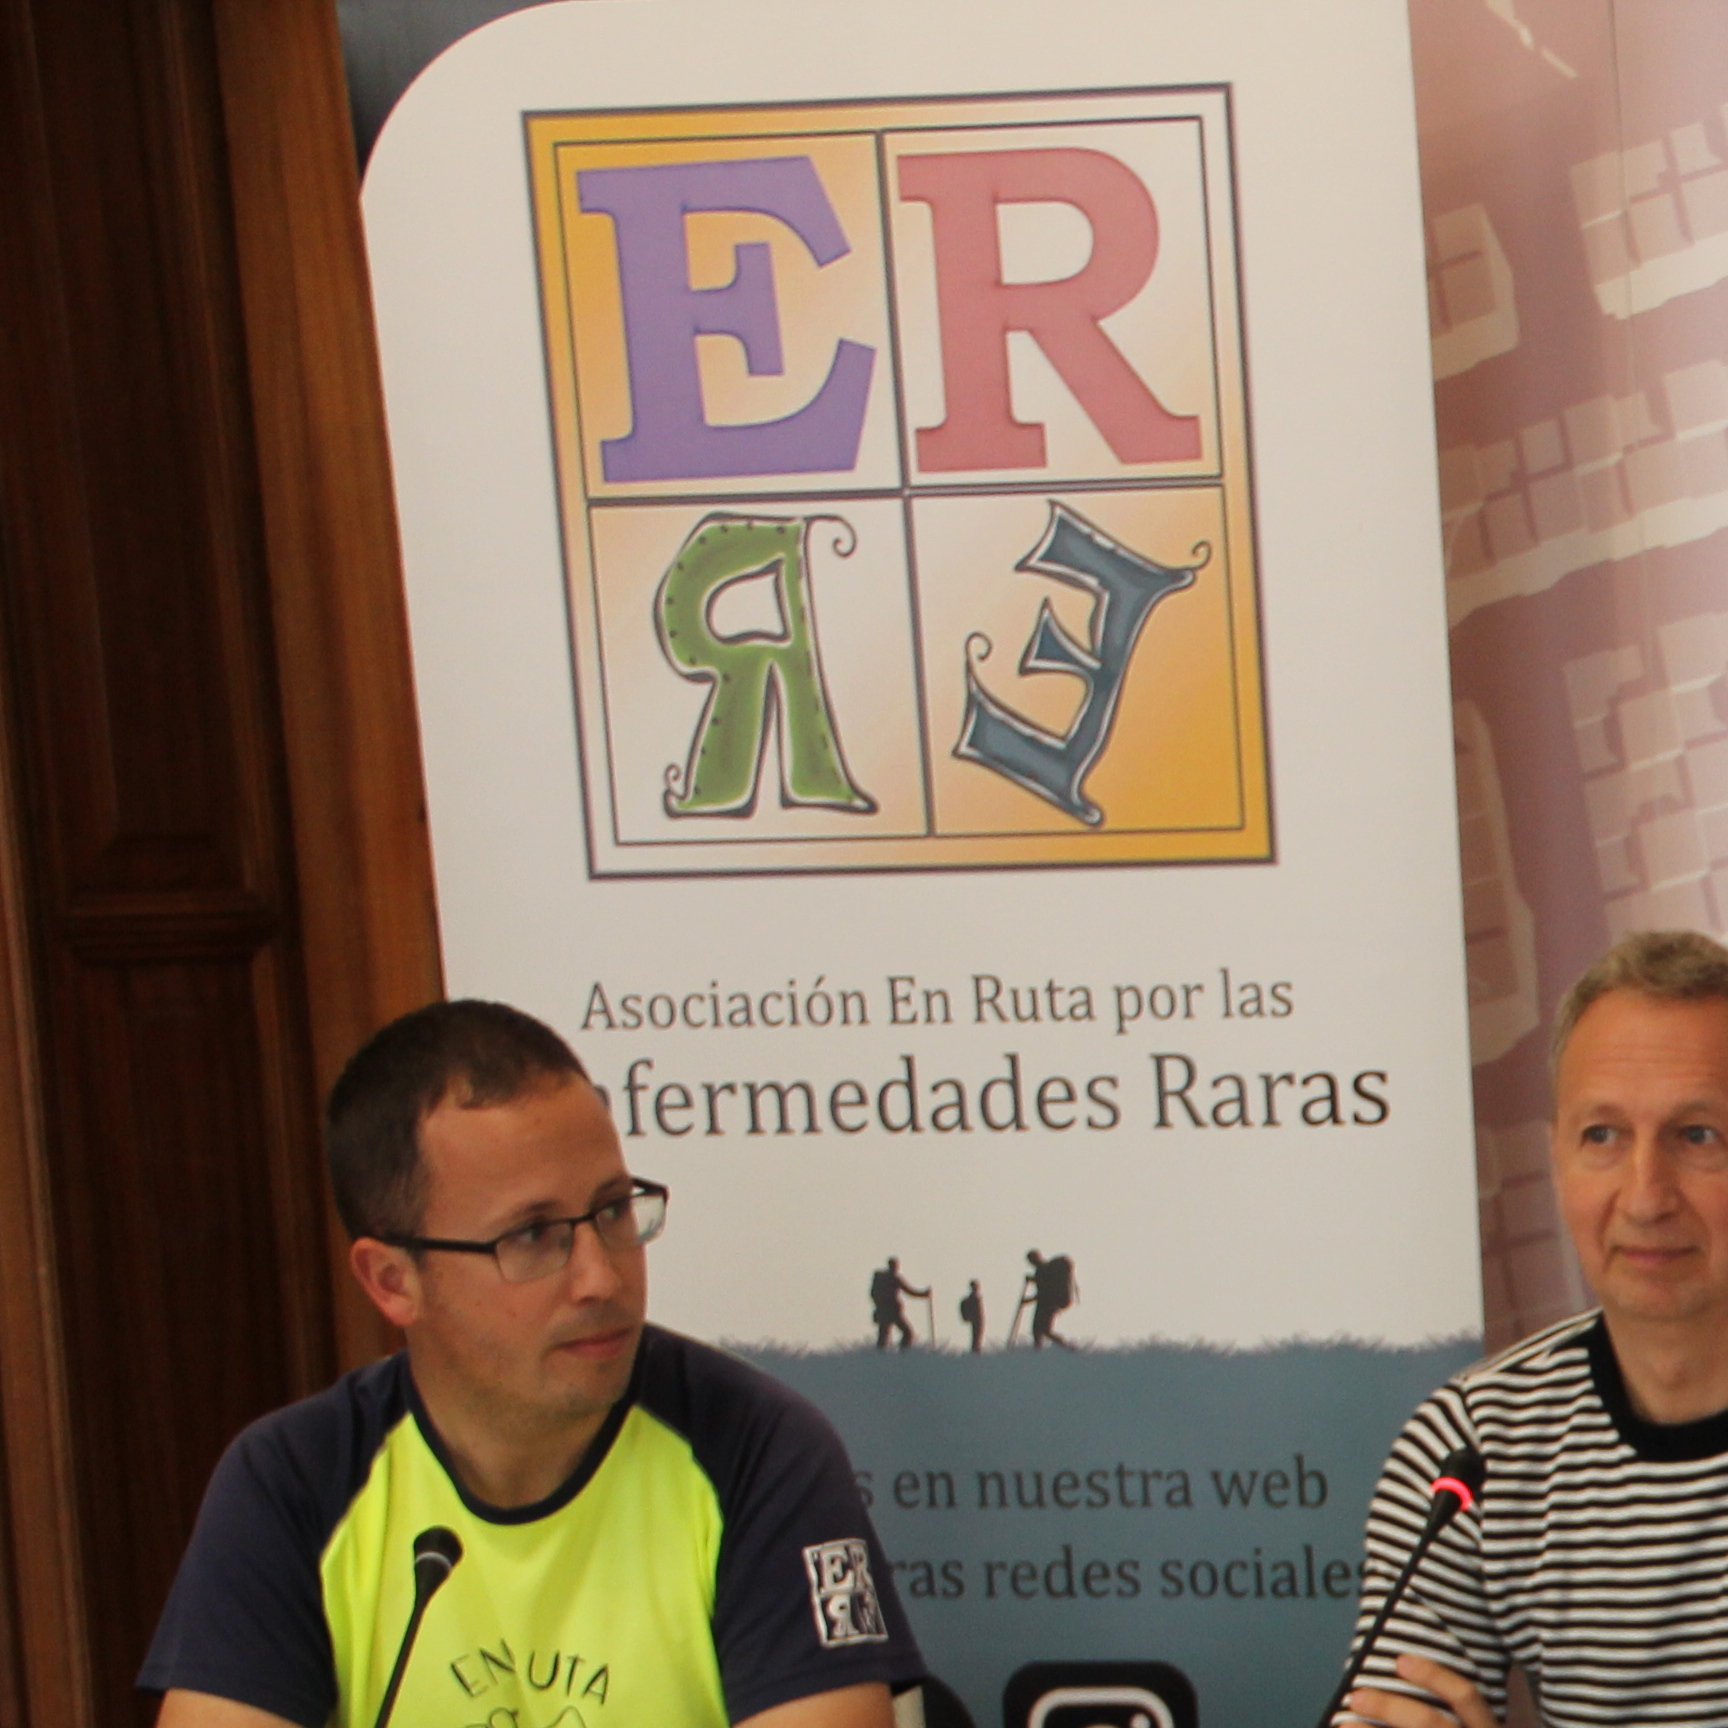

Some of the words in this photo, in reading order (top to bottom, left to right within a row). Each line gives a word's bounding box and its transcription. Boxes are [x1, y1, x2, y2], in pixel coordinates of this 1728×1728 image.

[581, 975, 870, 1031] Asociación
[888, 975, 954, 1026] En
[972, 974, 1097, 1024] Ruta
[1113, 982, 1205, 1036] por
[1220, 966, 1295, 1020] las
[594, 1051, 1122, 1138] fermedades
[1149, 1051, 1391, 1130] Raras
[893, 1467, 960, 1510] en
[976, 1461, 1195, 1510] nuestra
[1210, 1453, 1330, 1509] web
[985, 1543, 1142, 1599] redes
[1160, 1546, 1354, 1599] sociale
